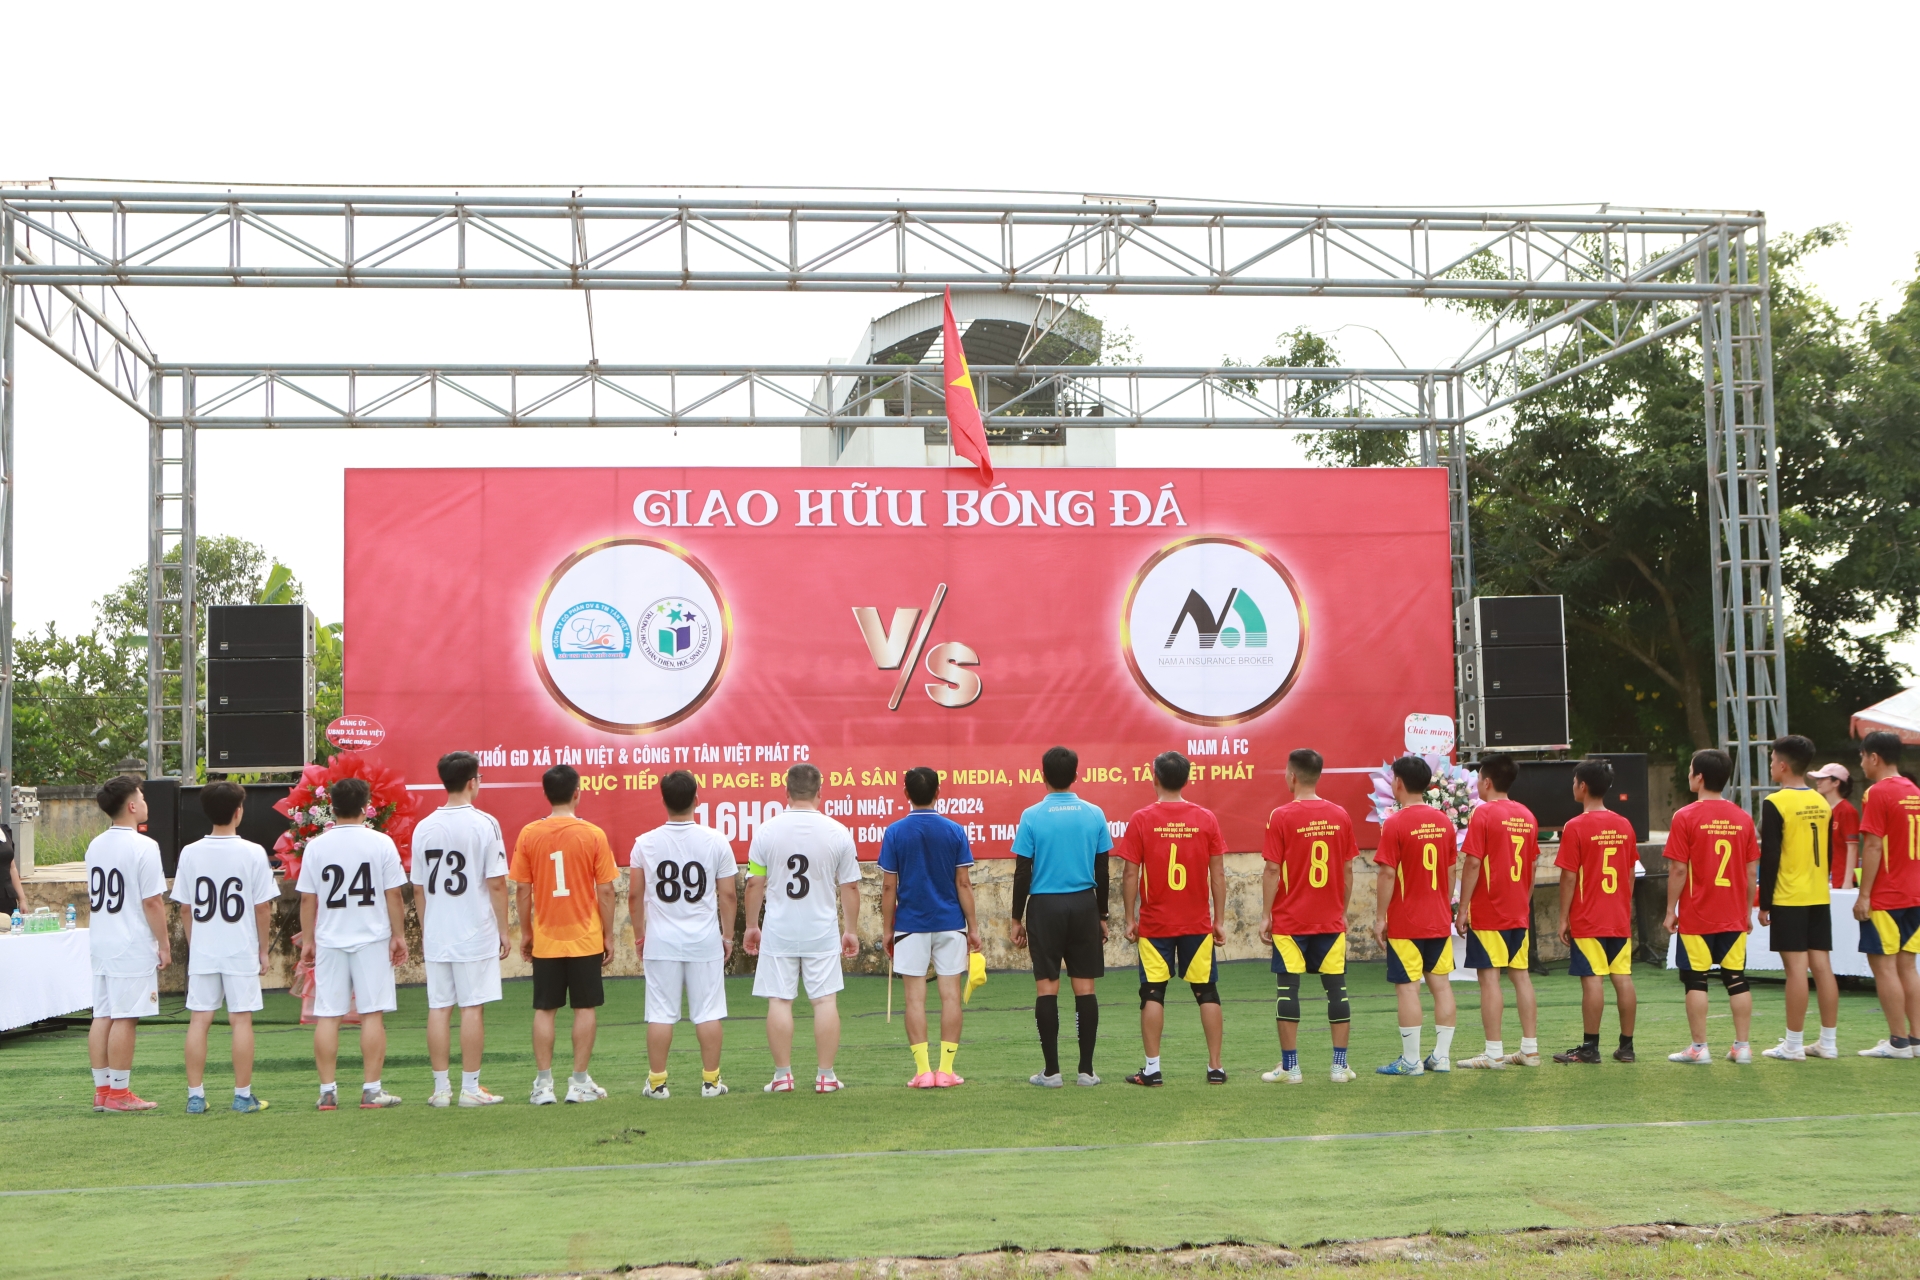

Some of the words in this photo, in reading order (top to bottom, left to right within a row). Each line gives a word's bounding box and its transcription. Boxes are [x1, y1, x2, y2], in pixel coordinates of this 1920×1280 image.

[633, 490, 736, 527] GIAO
[794, 482, 927, 527] HỮU
[942, 482, 1095, 527] BÓNG
[1109, 482, 1187, 527] ĐÁ
[1158, 658, 1177, 666] NAM
[1187, 657, 1236, 665] INSURANCE
[1238, 657, 1274, 665] BROKER
[1187, 739, 1217, 756] NAM
[1221, 736, 1230, 755] Á
[1233, 738, 1249, 755] FC
[1407, 726, 1428, 735] Chúc
[511, 750, 529, 767] GD
[533, 746, 551, 766] XÃ
[555, 745, 582, 765] TÂN
[585, 745, 614, 768] VIỆT
[618, 748, 628, 764] &
[633, 744, 670, 764] CÔNG
[674, 747, 690, 763] TY
[693, 743, 720, 763] TÂN
[723, 743, 752, 766] VIỆT
[755, 742, 790, 762] PHÁT
[793, 745, 810, 762] FC
[580, 774, 618, 796] RỰC
[623, 768, 659, 790] TIẾP
[712, 773, 765, 789] PAGE:
[830, 767, 856, 786] ĐÁ
[861, 767, 897, 786] SÂN
[953, 769, 1013, 787] MEDIA,
[1081, 767, 1127, 784] JIBC,
[1132, 762, 1154, 782] TÂ
[1211, 760, 1255, 780] PHÁT
[824, 794, 853, 816] CHỦ
[857, 796, 894, 818] NHẬT
[1167, 842, 1187, 891] 6
[1309, 840, 1329, 888] 8
[1423, 843, 1438, 891] 9
[1510, 835, 1525, 882] 3
[1714, 839, 1732, 887] 2
[1810, 822, 1820, 867] 1
[90, 866, 125, 914] 99
[321, 862, 376, 909] 24
[425, 849, 468, 896] 73
[549, 850, 571, 897] 1
[655, 860, 707, 903] 89
[786, 853, 810, 900] 3
[1601, 847, 1618, 894] 5
[194, 876, 245, 923] 96
